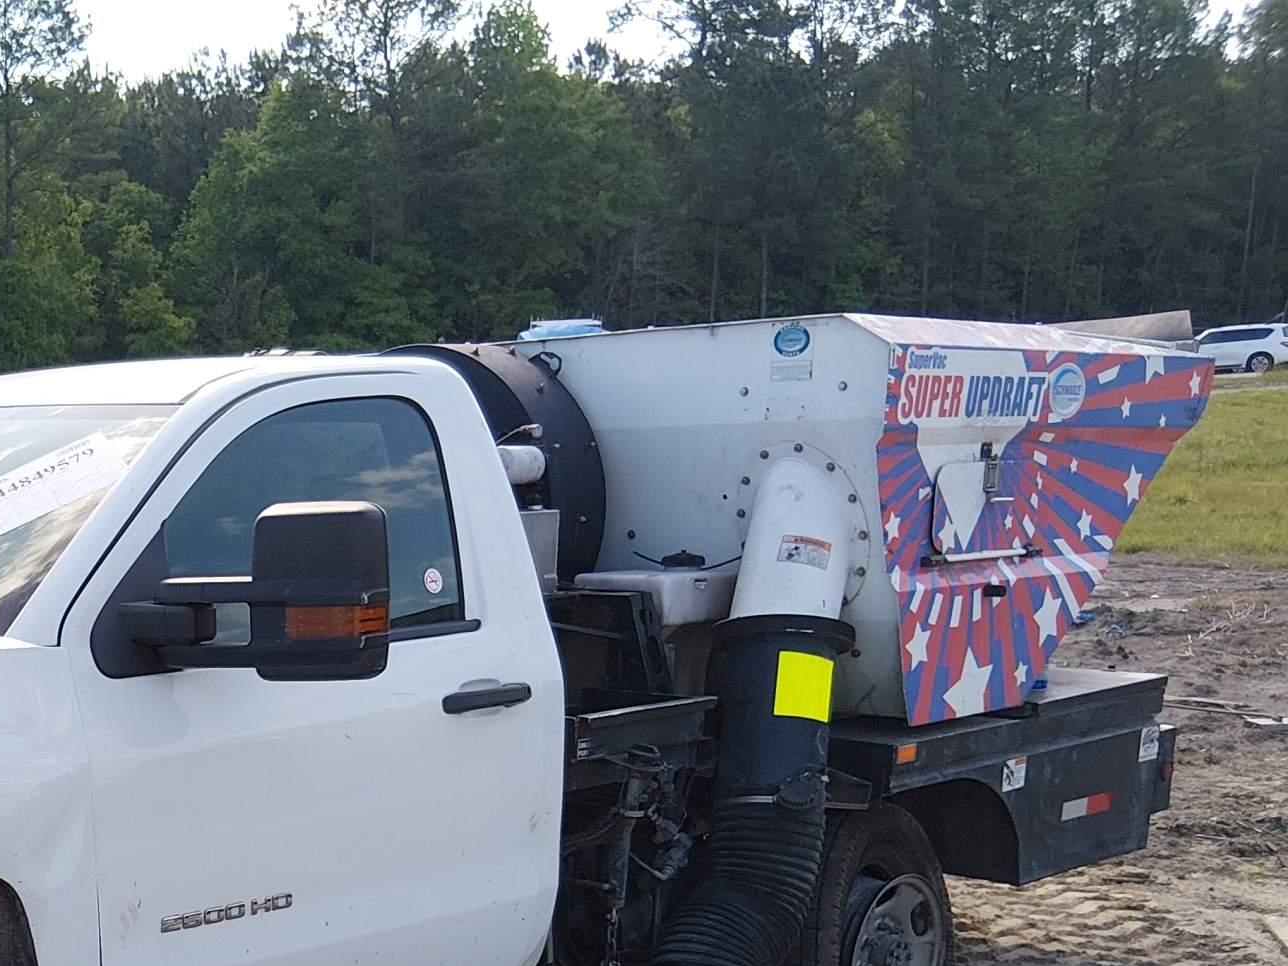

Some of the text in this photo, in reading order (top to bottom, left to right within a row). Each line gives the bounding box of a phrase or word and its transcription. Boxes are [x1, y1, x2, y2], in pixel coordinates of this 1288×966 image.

[908, 351, 948, 370] SuperVac
[900, 374, 1046, 419] SUPER UPDRAFT
[160, 893, 292, 933] 2500 HD
